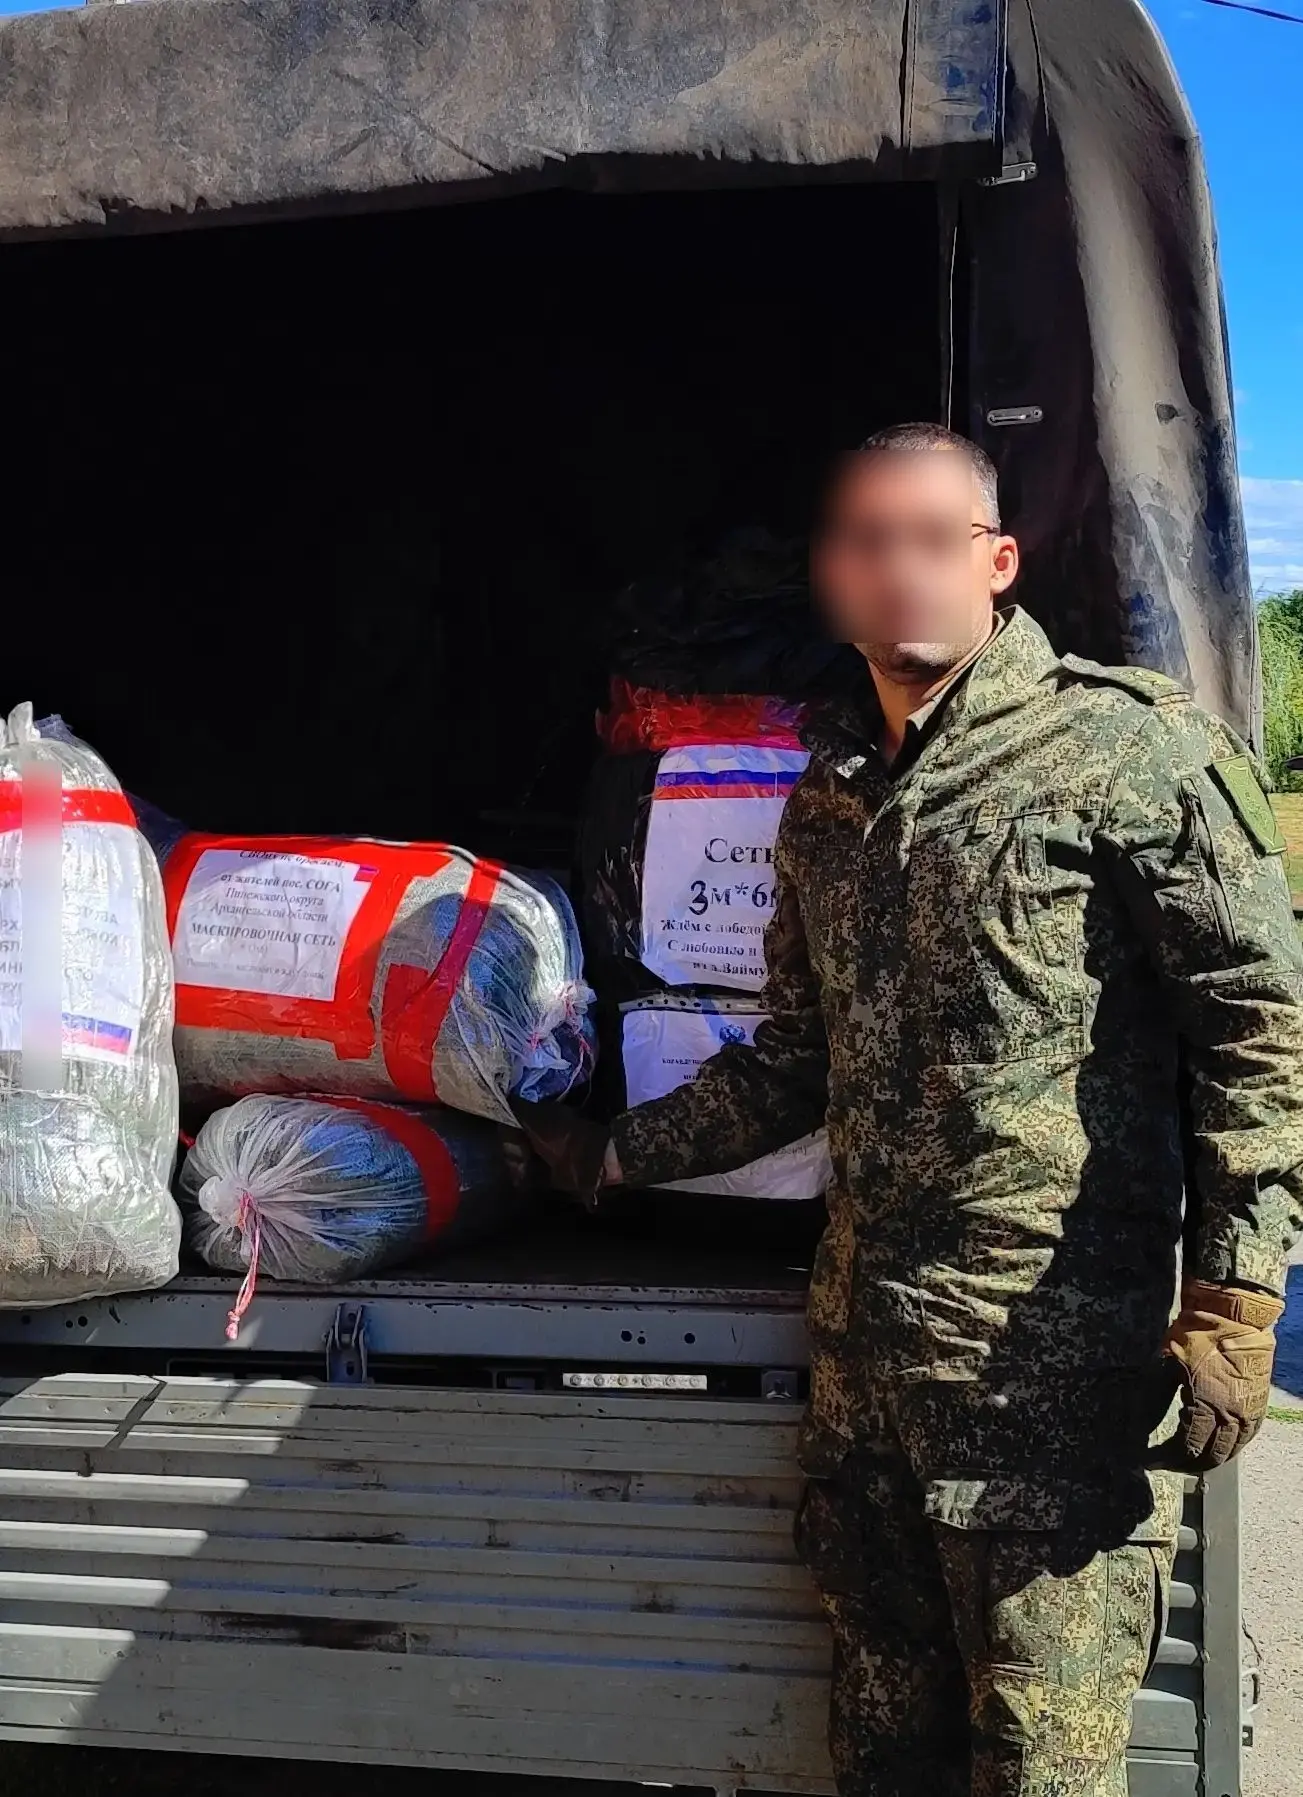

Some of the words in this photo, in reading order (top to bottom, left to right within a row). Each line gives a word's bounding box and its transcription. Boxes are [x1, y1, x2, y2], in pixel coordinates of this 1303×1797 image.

[289, 896, 325, 907] округа
[190, 922, 300, 944] МАСКИРОВОЧНАЯ
[303, 932, 337, 948] СЕТЬ
